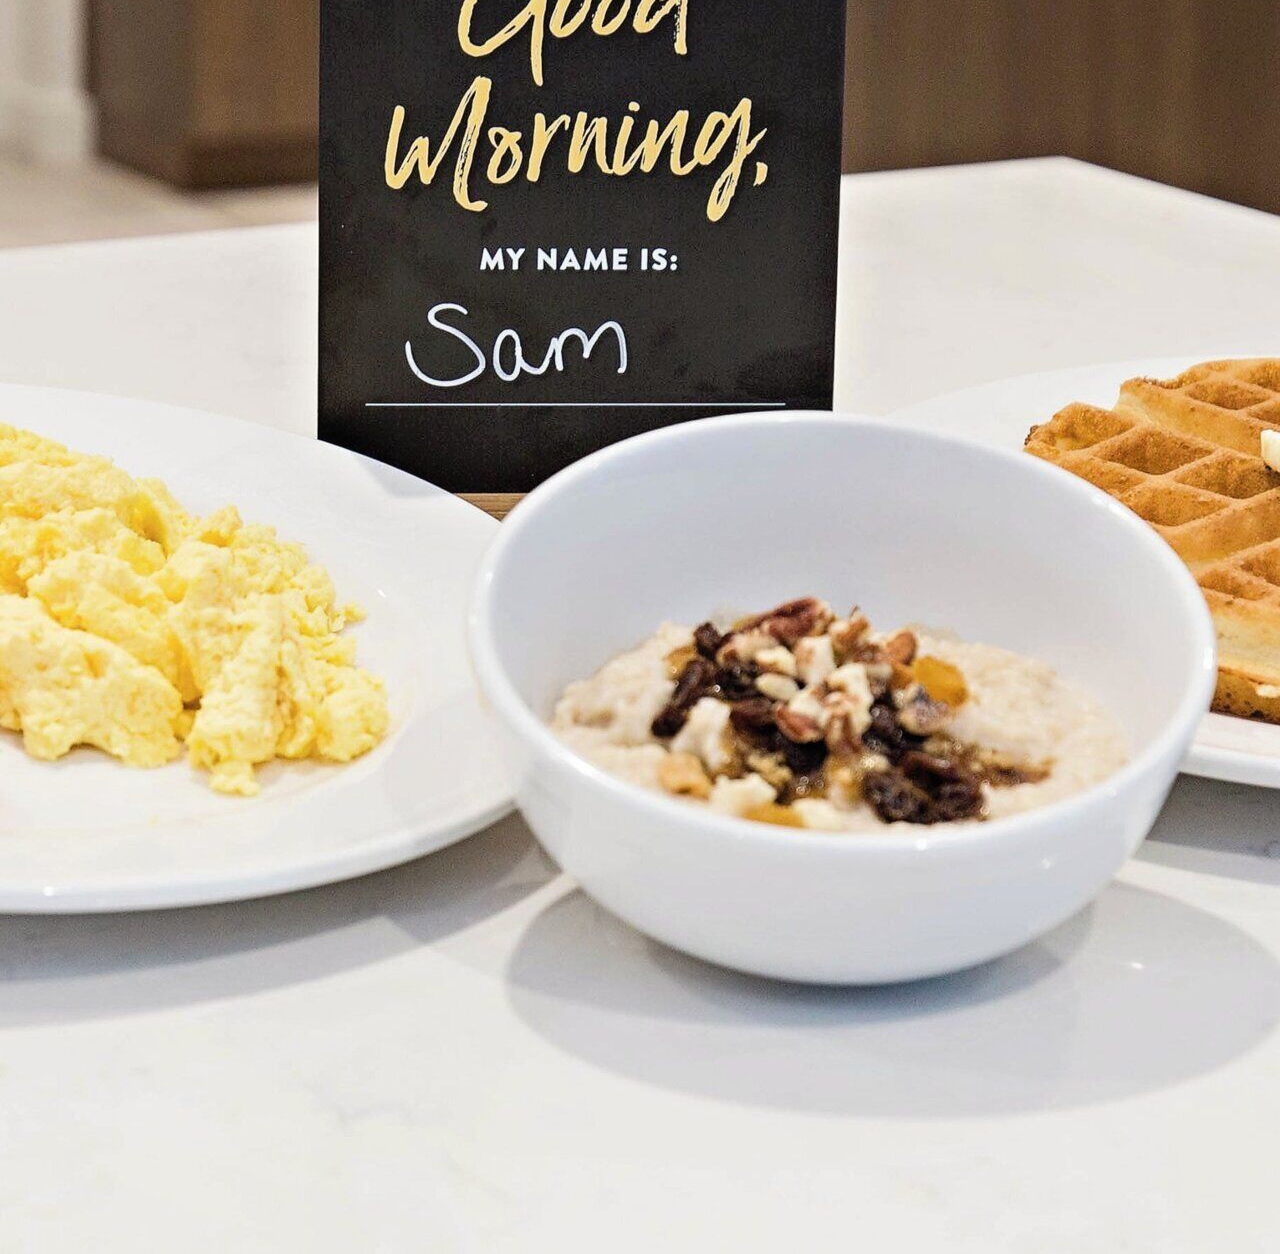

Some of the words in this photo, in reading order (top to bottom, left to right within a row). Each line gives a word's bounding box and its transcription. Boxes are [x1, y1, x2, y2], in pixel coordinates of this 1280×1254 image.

[384, 75, 769, 223] Morning,
[480, 247, 526, 271] MY
[536, 247, 629, 271] NAME
[640, 247, 678, 271] IS:
[404, 302, 628, 388] Sam
